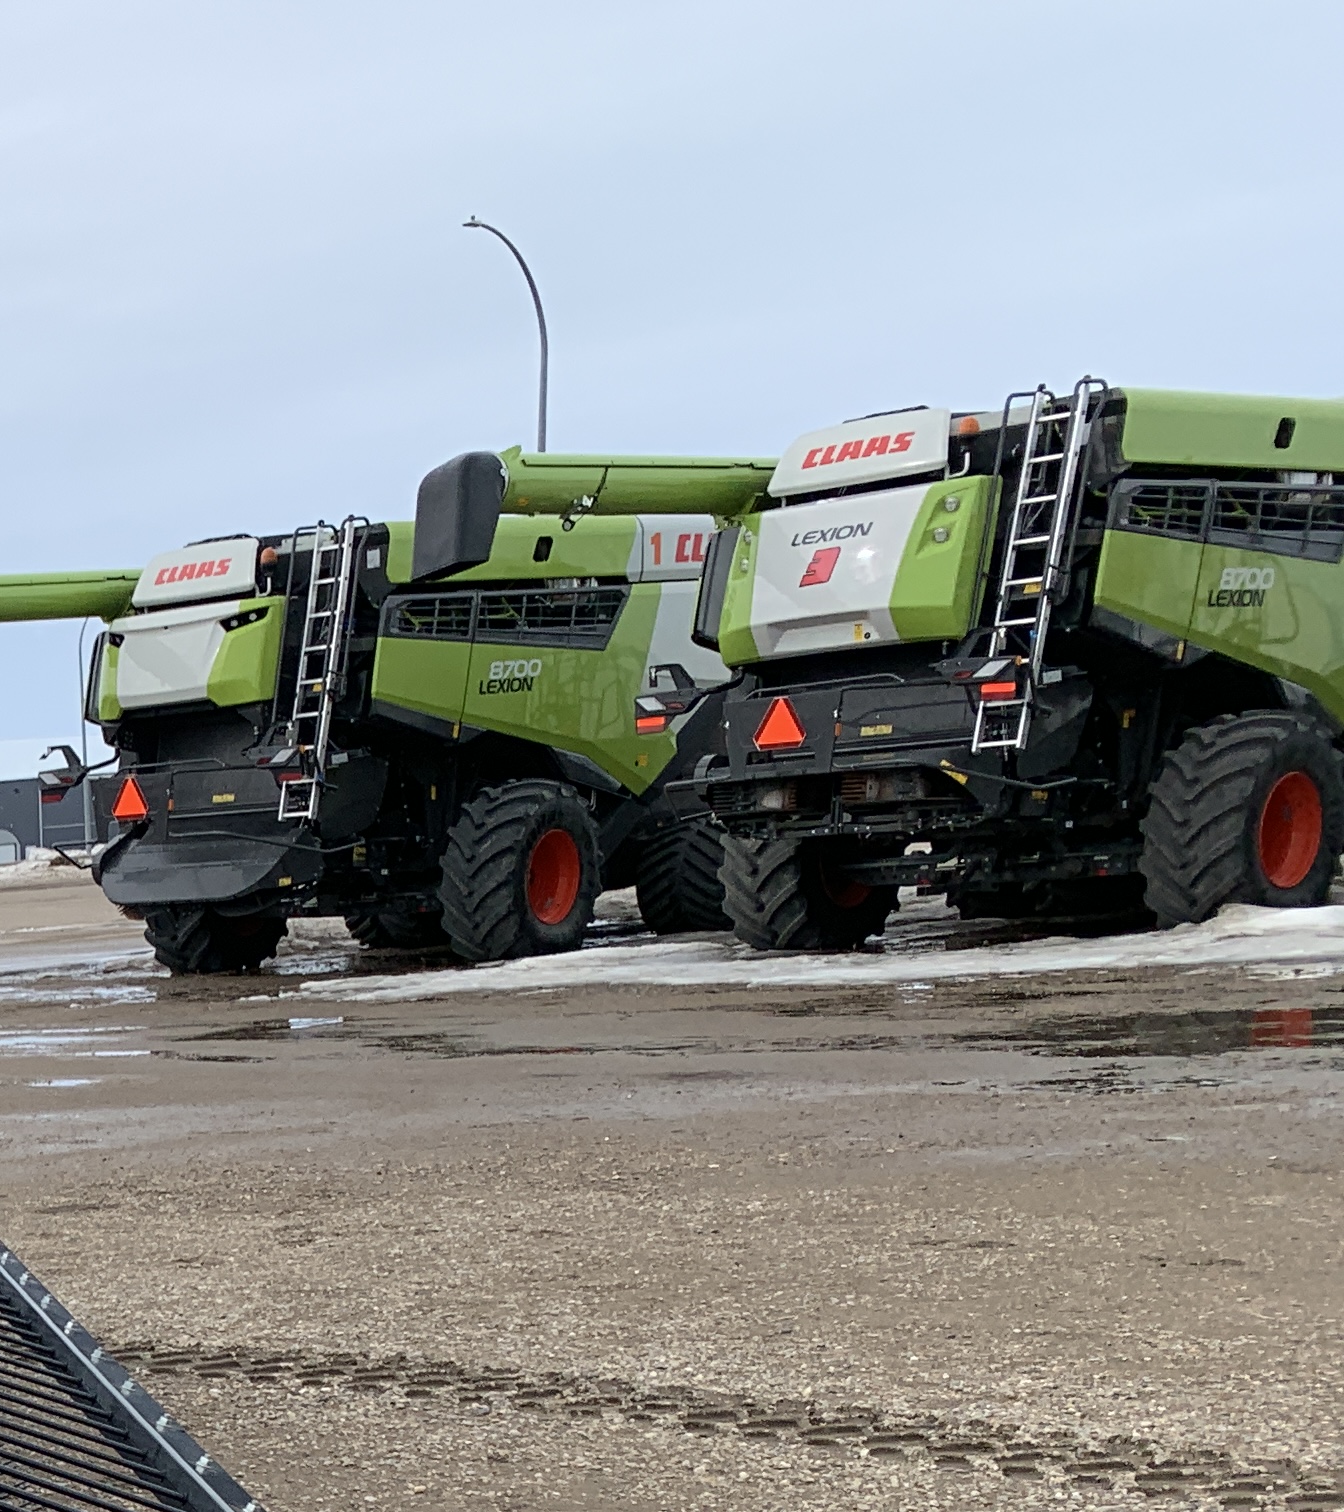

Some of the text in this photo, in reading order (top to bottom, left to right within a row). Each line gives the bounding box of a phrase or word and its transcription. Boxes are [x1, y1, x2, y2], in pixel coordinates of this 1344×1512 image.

[801, 431, 915, 469] CLAAS
[791, 522, 873, 547] LEXION
[650, 532, 661, 565] 1
[154, 558, 232, 586] CLAAS
[1220, 567, 1275, 589] 8700
[1207, 589, 1266, 607] LEXION
[489, 659, 542, 680] 8700
[479, 677, 533, 695] LEXION
